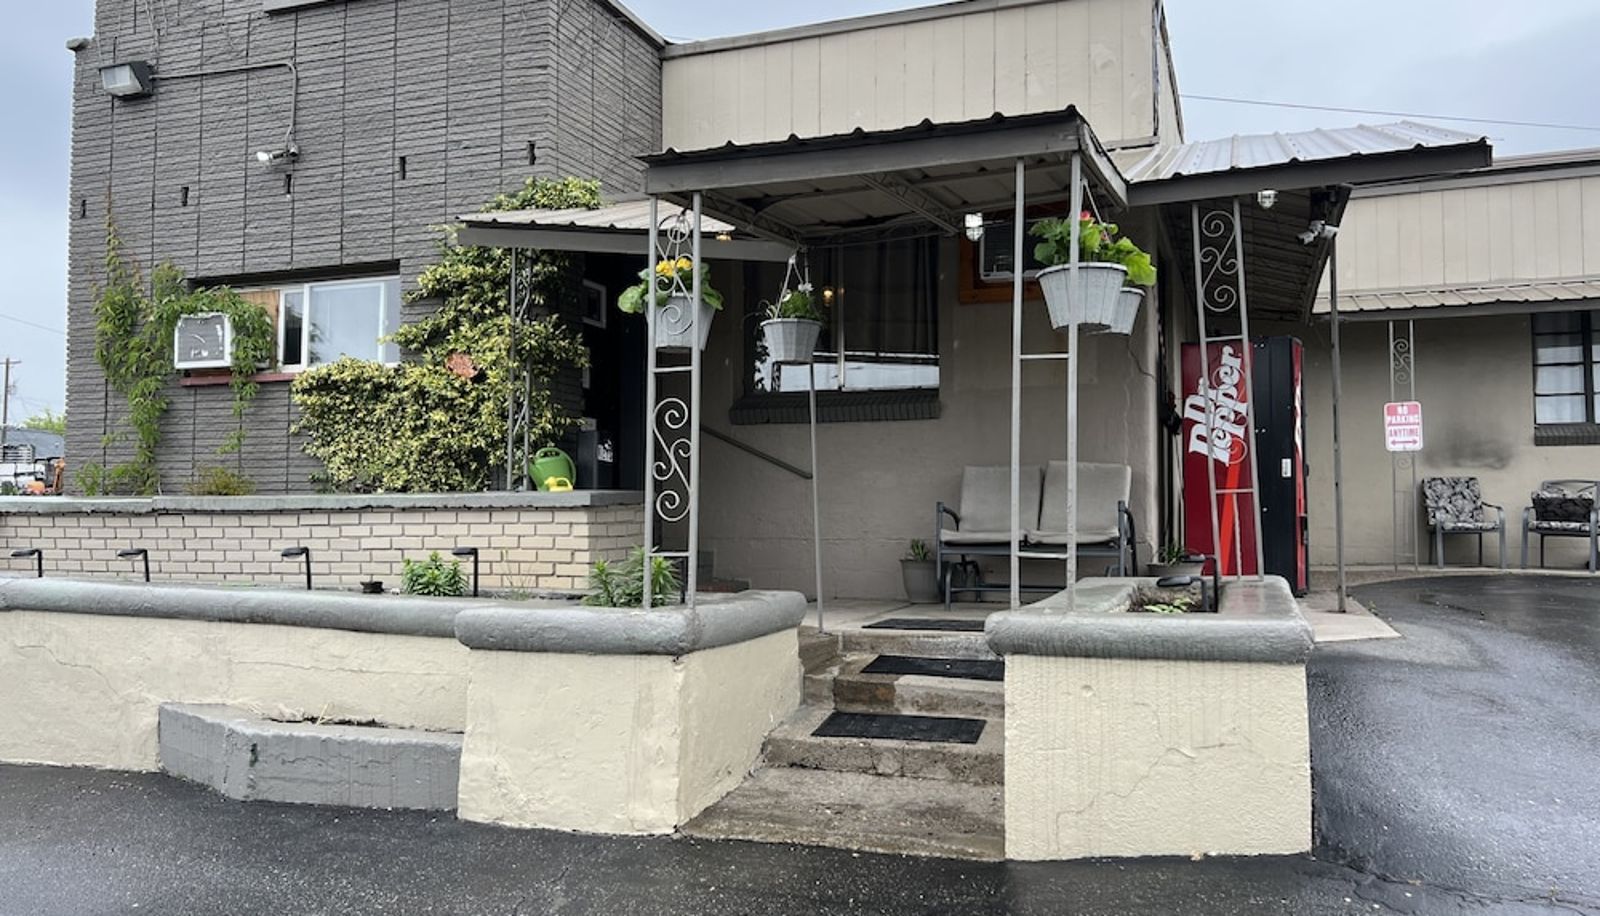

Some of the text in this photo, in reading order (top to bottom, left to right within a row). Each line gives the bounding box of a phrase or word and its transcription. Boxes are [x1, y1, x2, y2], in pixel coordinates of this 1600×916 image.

[1184, 377, 1217, 424] Dr
[1188, 345, 1247, 467] Pepper
[1396, 405, 1408, 415] NO
[1387, 415, 1419, 425] PARKING
[1389, 427, 1419, 437] ANYTIME
